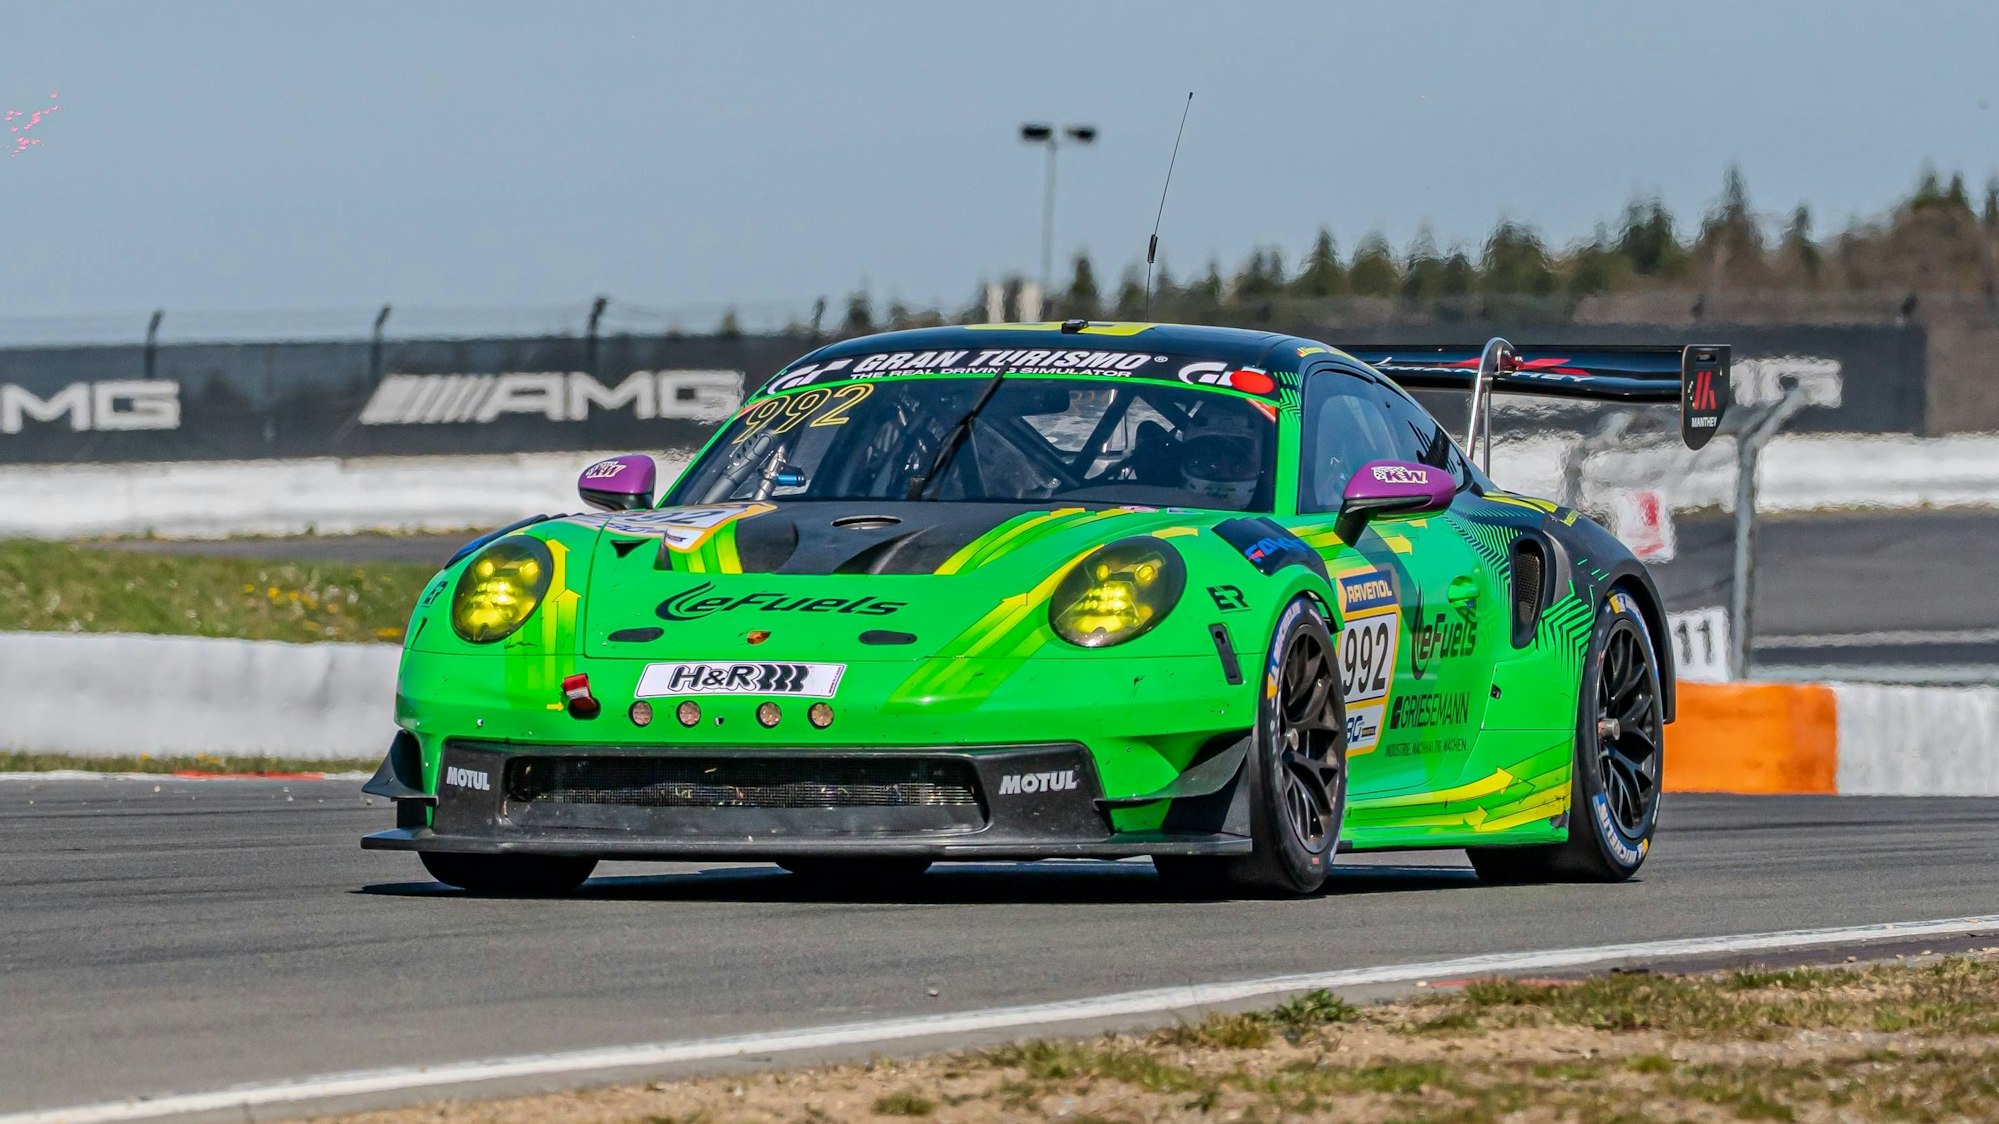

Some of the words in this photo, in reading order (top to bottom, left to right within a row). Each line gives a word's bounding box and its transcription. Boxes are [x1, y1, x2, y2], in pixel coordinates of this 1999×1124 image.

[853, 350, 969, 373] GRAN
[968, 349, 1151, 370] TURISMO
[850, 373, 885, 381] THE
[888, 368, 934, 377] REAL
[1019, 367, 1132, 378] SIMULATOR
[475, 370, 744, 422] AMG
[731, 383, 875, 444] 992
[1691, 416, 1718, 428] MANTHEY
[1384, 470, 1429, 484] KW
[1346, 579, 1393, 603] RAVENOL
[679, 591, 908, 617] eFuels
[1417, 610, 1478, 664] eFuels
[1343, 622, 1389, 697] 992
[669, 665, 757, 690] H&R
[1400, 691, 1470, 728] GRIESEMANN
[446, 766, 490, 791] MOTUL
[998, 770, 1078, 794] MOTUL
